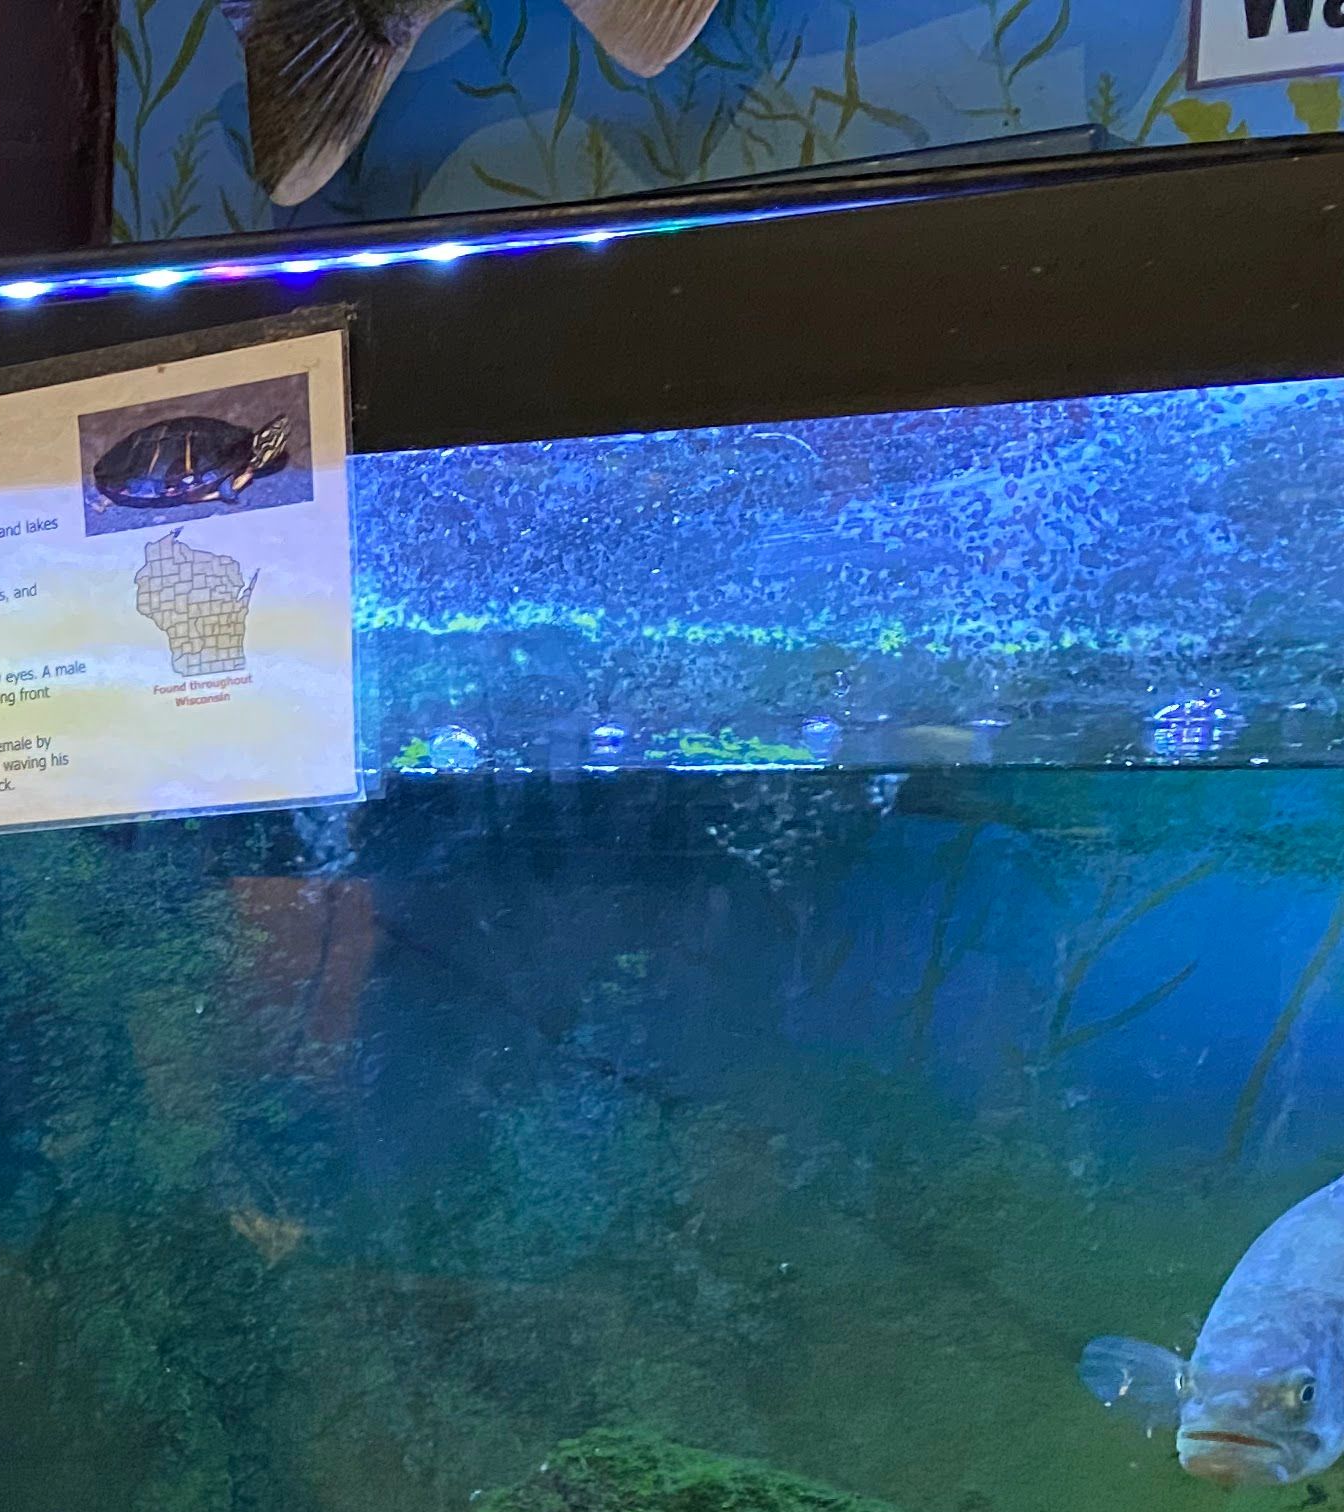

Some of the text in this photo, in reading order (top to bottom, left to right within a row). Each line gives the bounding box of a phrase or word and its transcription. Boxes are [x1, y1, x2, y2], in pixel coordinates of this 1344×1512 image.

[26, 516, 58, 534] lakes
[14, 584, 37, 599] and
[6, 669, 37, 685] eyes.
[42, 665, 51, 678] A
[55, 661, 86, 677] male
[154, 674, 253, 695] Found throughout
[19, 686, 50, 701] front
[176, 692, 230, 706] Wisconsin
[36, 735, 51, 752] by
[4, 755, 47, 773] waving
[51, 753, 69, 767] his
